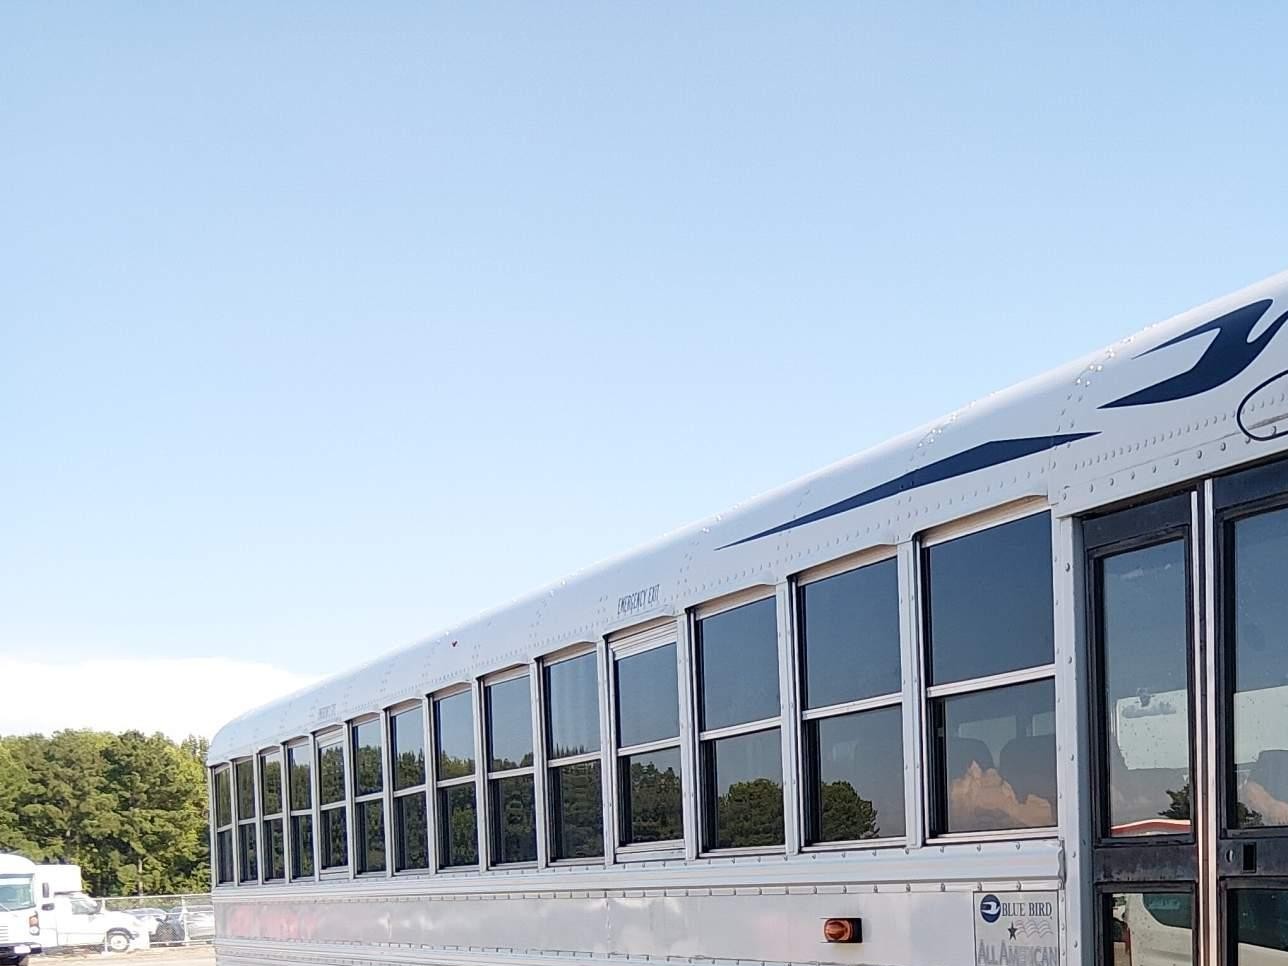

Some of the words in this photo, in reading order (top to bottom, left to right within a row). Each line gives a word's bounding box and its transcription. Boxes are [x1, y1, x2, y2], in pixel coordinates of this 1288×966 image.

[648, 583, 660, 606] EXIT
[1001, 902, 1025, 917] BLUE
[1028, 901, 1053, 918] BIRD
[977, 938, 999, 966] ALL
